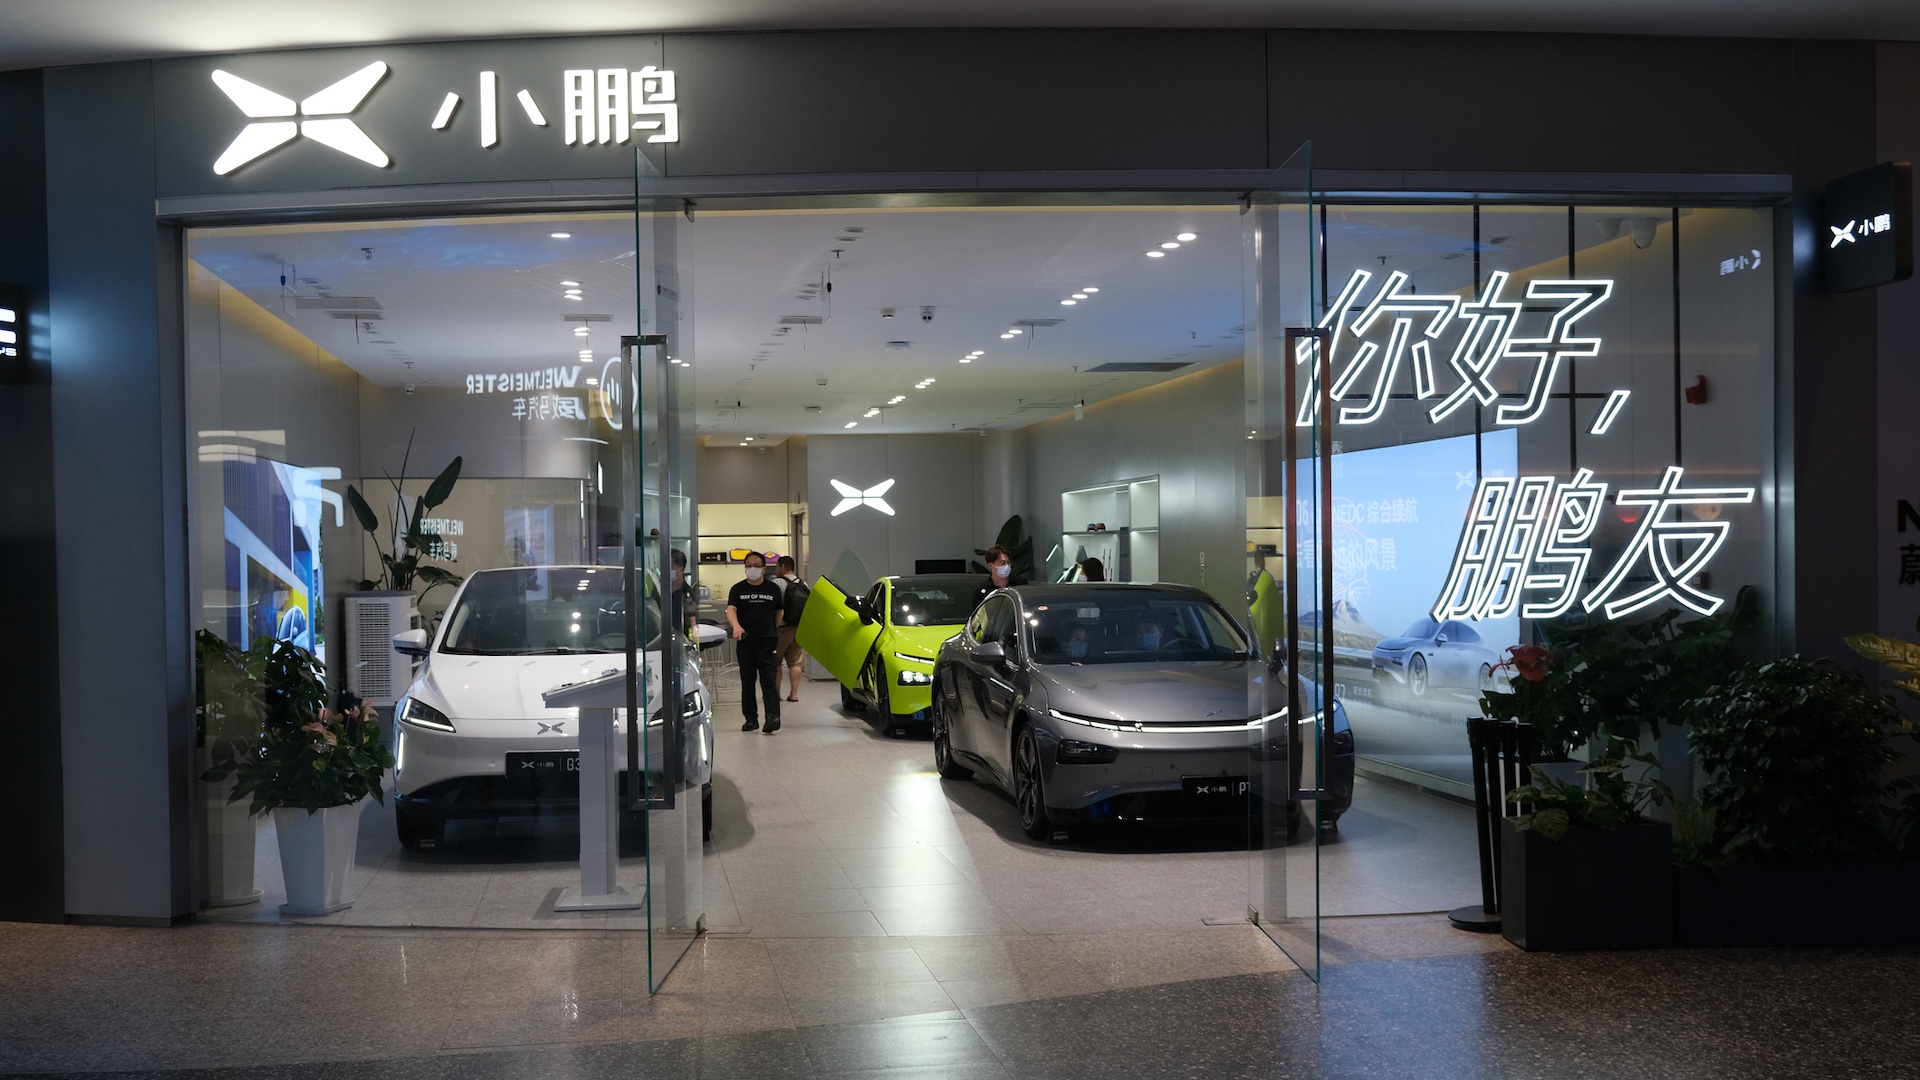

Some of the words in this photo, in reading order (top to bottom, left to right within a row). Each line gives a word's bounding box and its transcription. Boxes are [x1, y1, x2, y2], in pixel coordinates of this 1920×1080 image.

[431, 65, 679, 148] 小鹏
[1858, 213, 1891, 236] 小鹏
[1432, 466, 1755, 623] 鹏友
